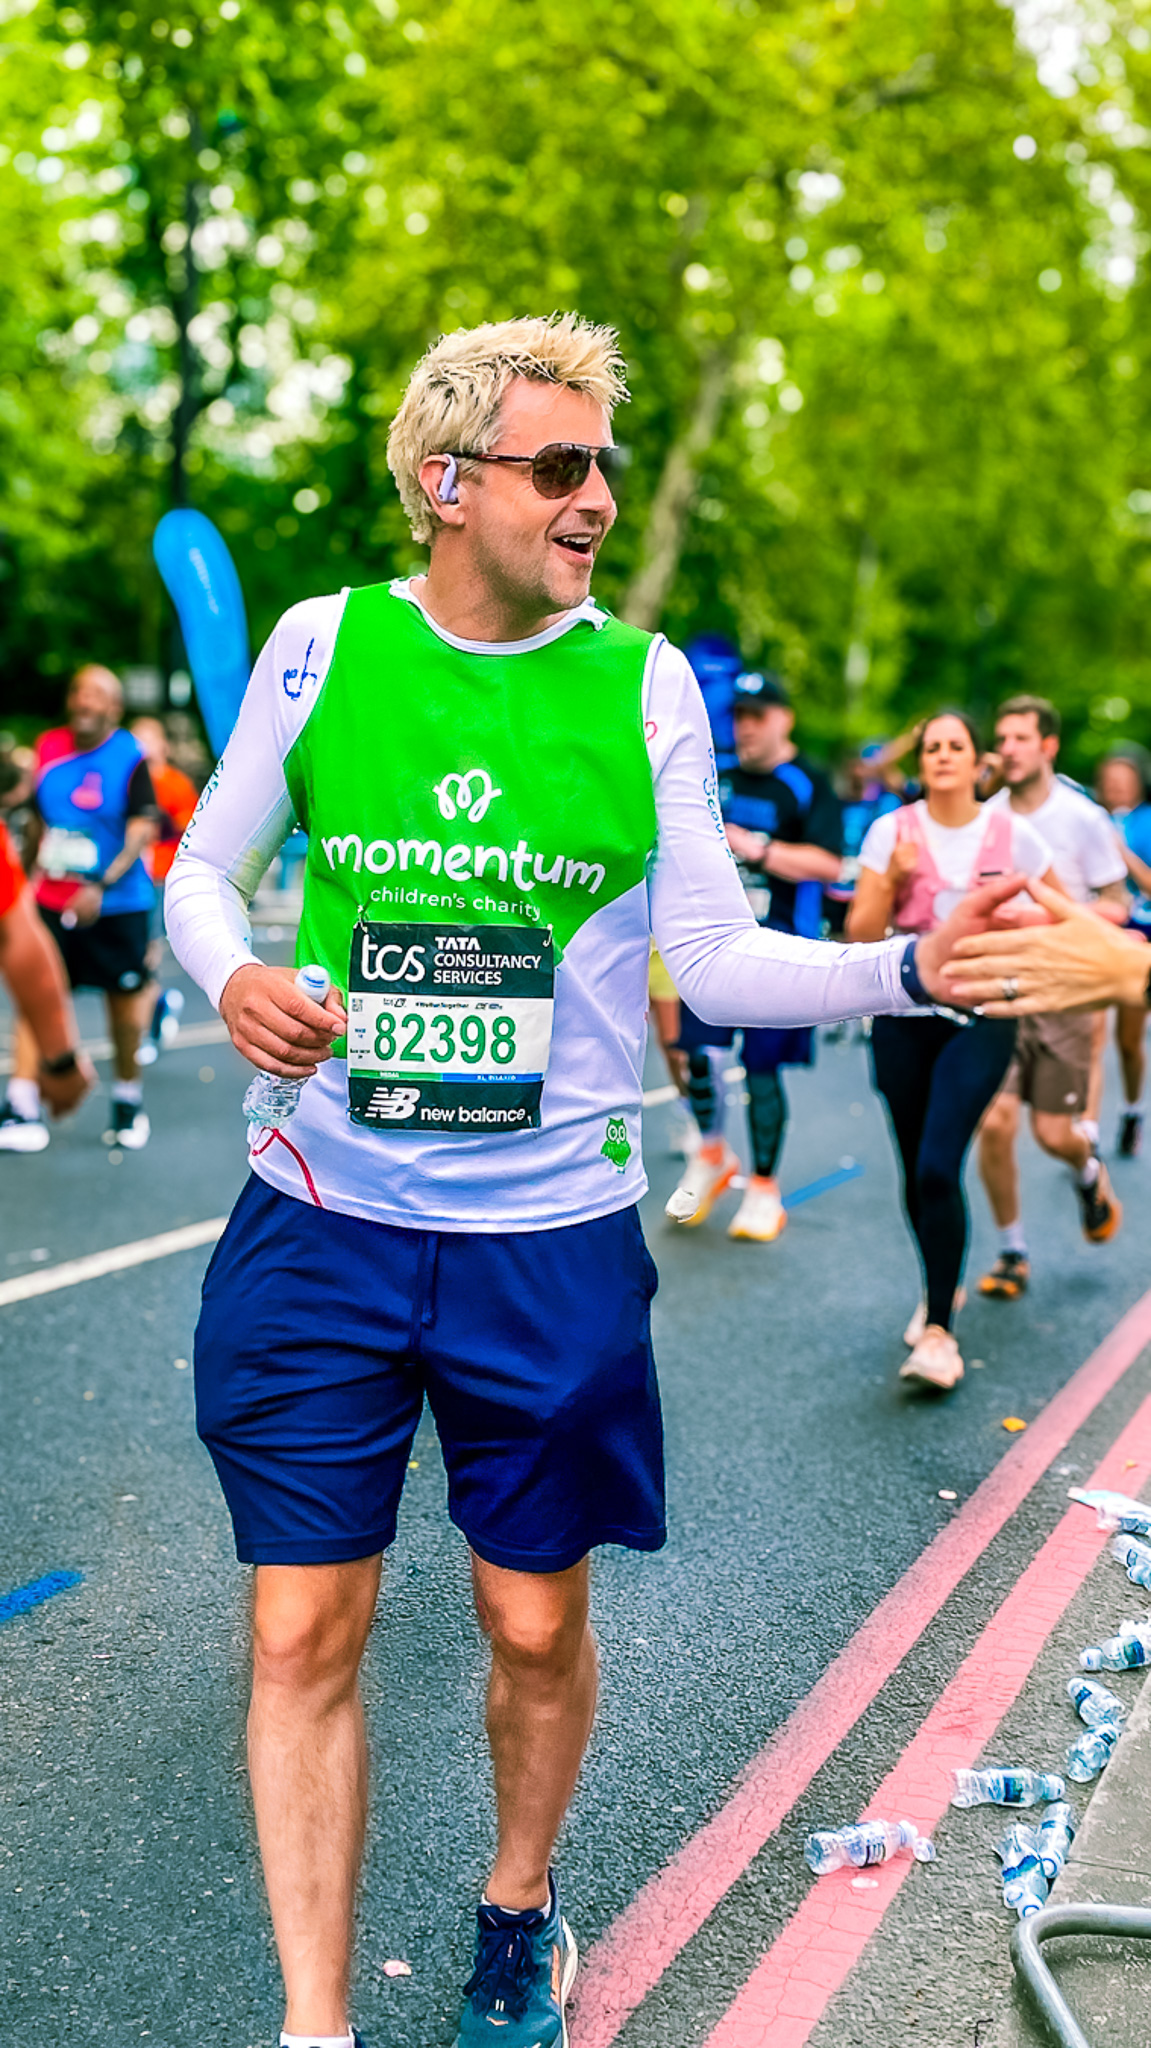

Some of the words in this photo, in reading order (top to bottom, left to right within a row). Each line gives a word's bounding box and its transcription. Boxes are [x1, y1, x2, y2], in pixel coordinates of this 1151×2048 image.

[321, 833, 607, 895] momentum
[370, 885, 467, 909] children's
[472, 895, 541, 922] charity
[434, 936, 482, 951] TATA
[361, 934, 426, 983] tcs
[433, 953, 542, 969] CONSULTANCY
[433, 970, 503, 985] SERVICES
[373, 1012, 517, 1065] 82398
[421, 1106, 456, 1122] new
[458, 1106, 526, 1123] balance
